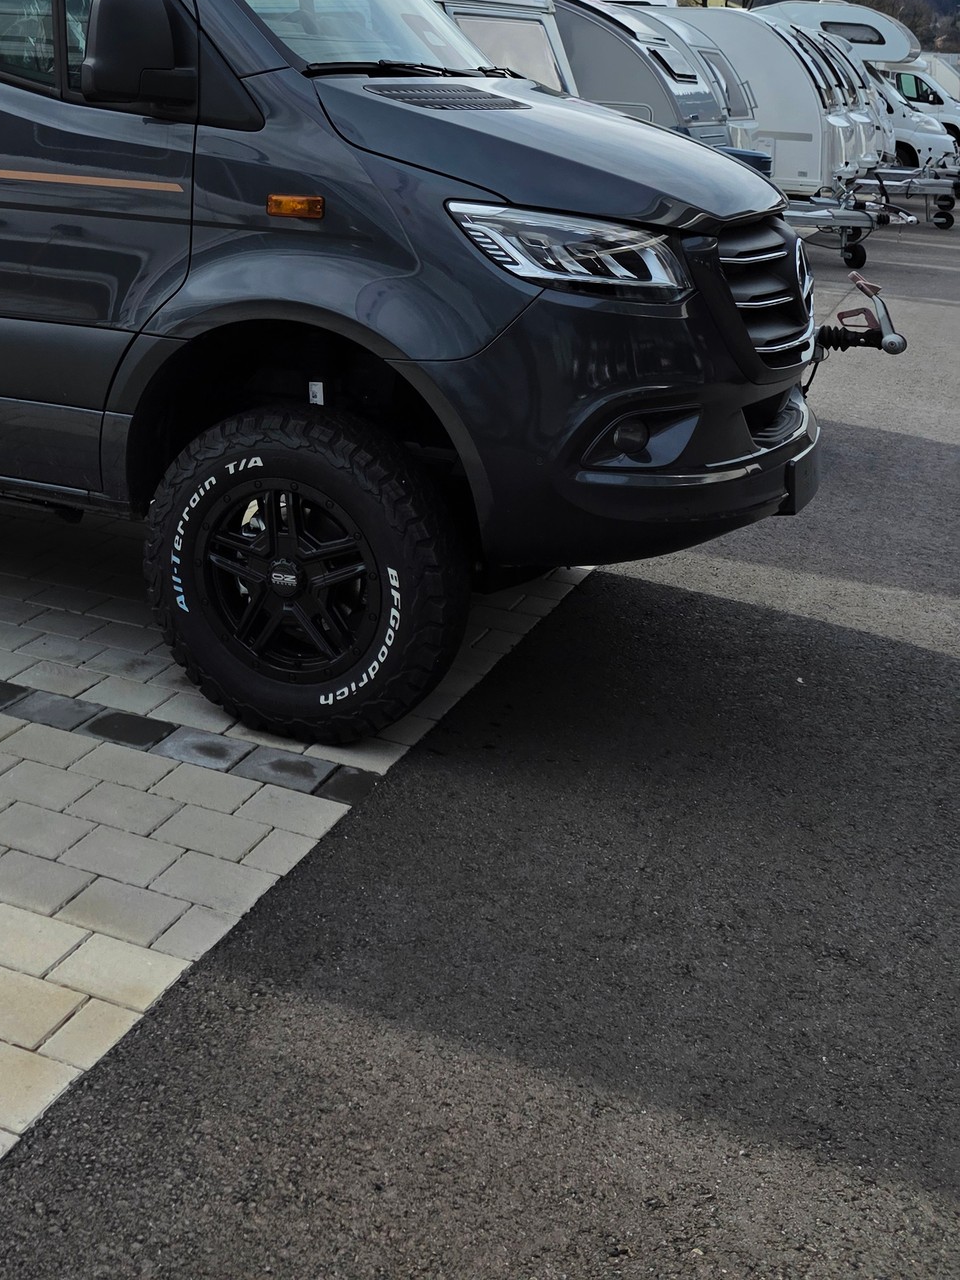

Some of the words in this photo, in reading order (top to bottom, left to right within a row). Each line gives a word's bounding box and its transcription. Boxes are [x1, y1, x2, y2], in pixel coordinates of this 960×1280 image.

[170, 476, 217, 613] All-Terrain
[225, 456, 264, 475] T/A
[272, 573, 296, 582] OZ
[319, 567, 402, 706] BFGoodrich
